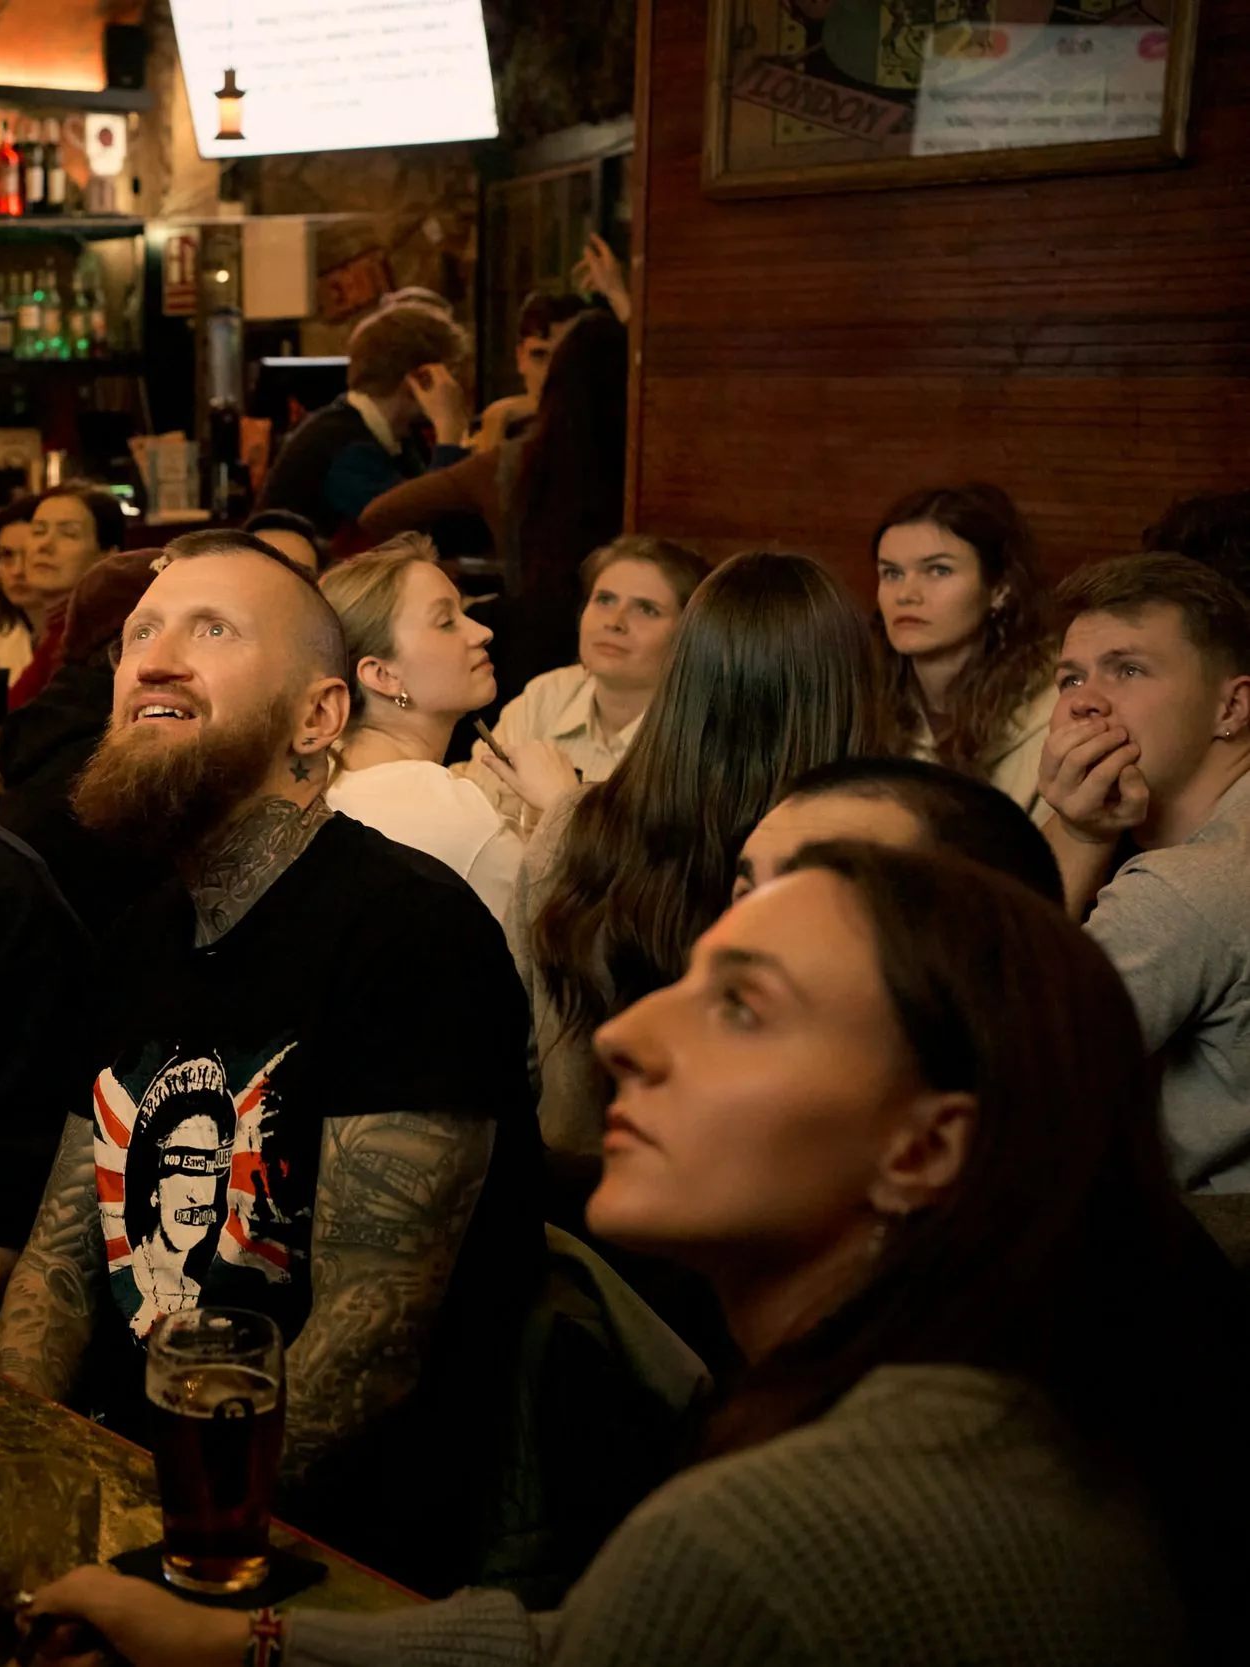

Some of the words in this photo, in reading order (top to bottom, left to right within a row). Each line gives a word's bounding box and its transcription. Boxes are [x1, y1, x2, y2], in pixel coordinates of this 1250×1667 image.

[748, 69, 890, 133] LONDON
[164, 1154, 181, 1166] GOD
[184, 1156, 205, 1168] Save
